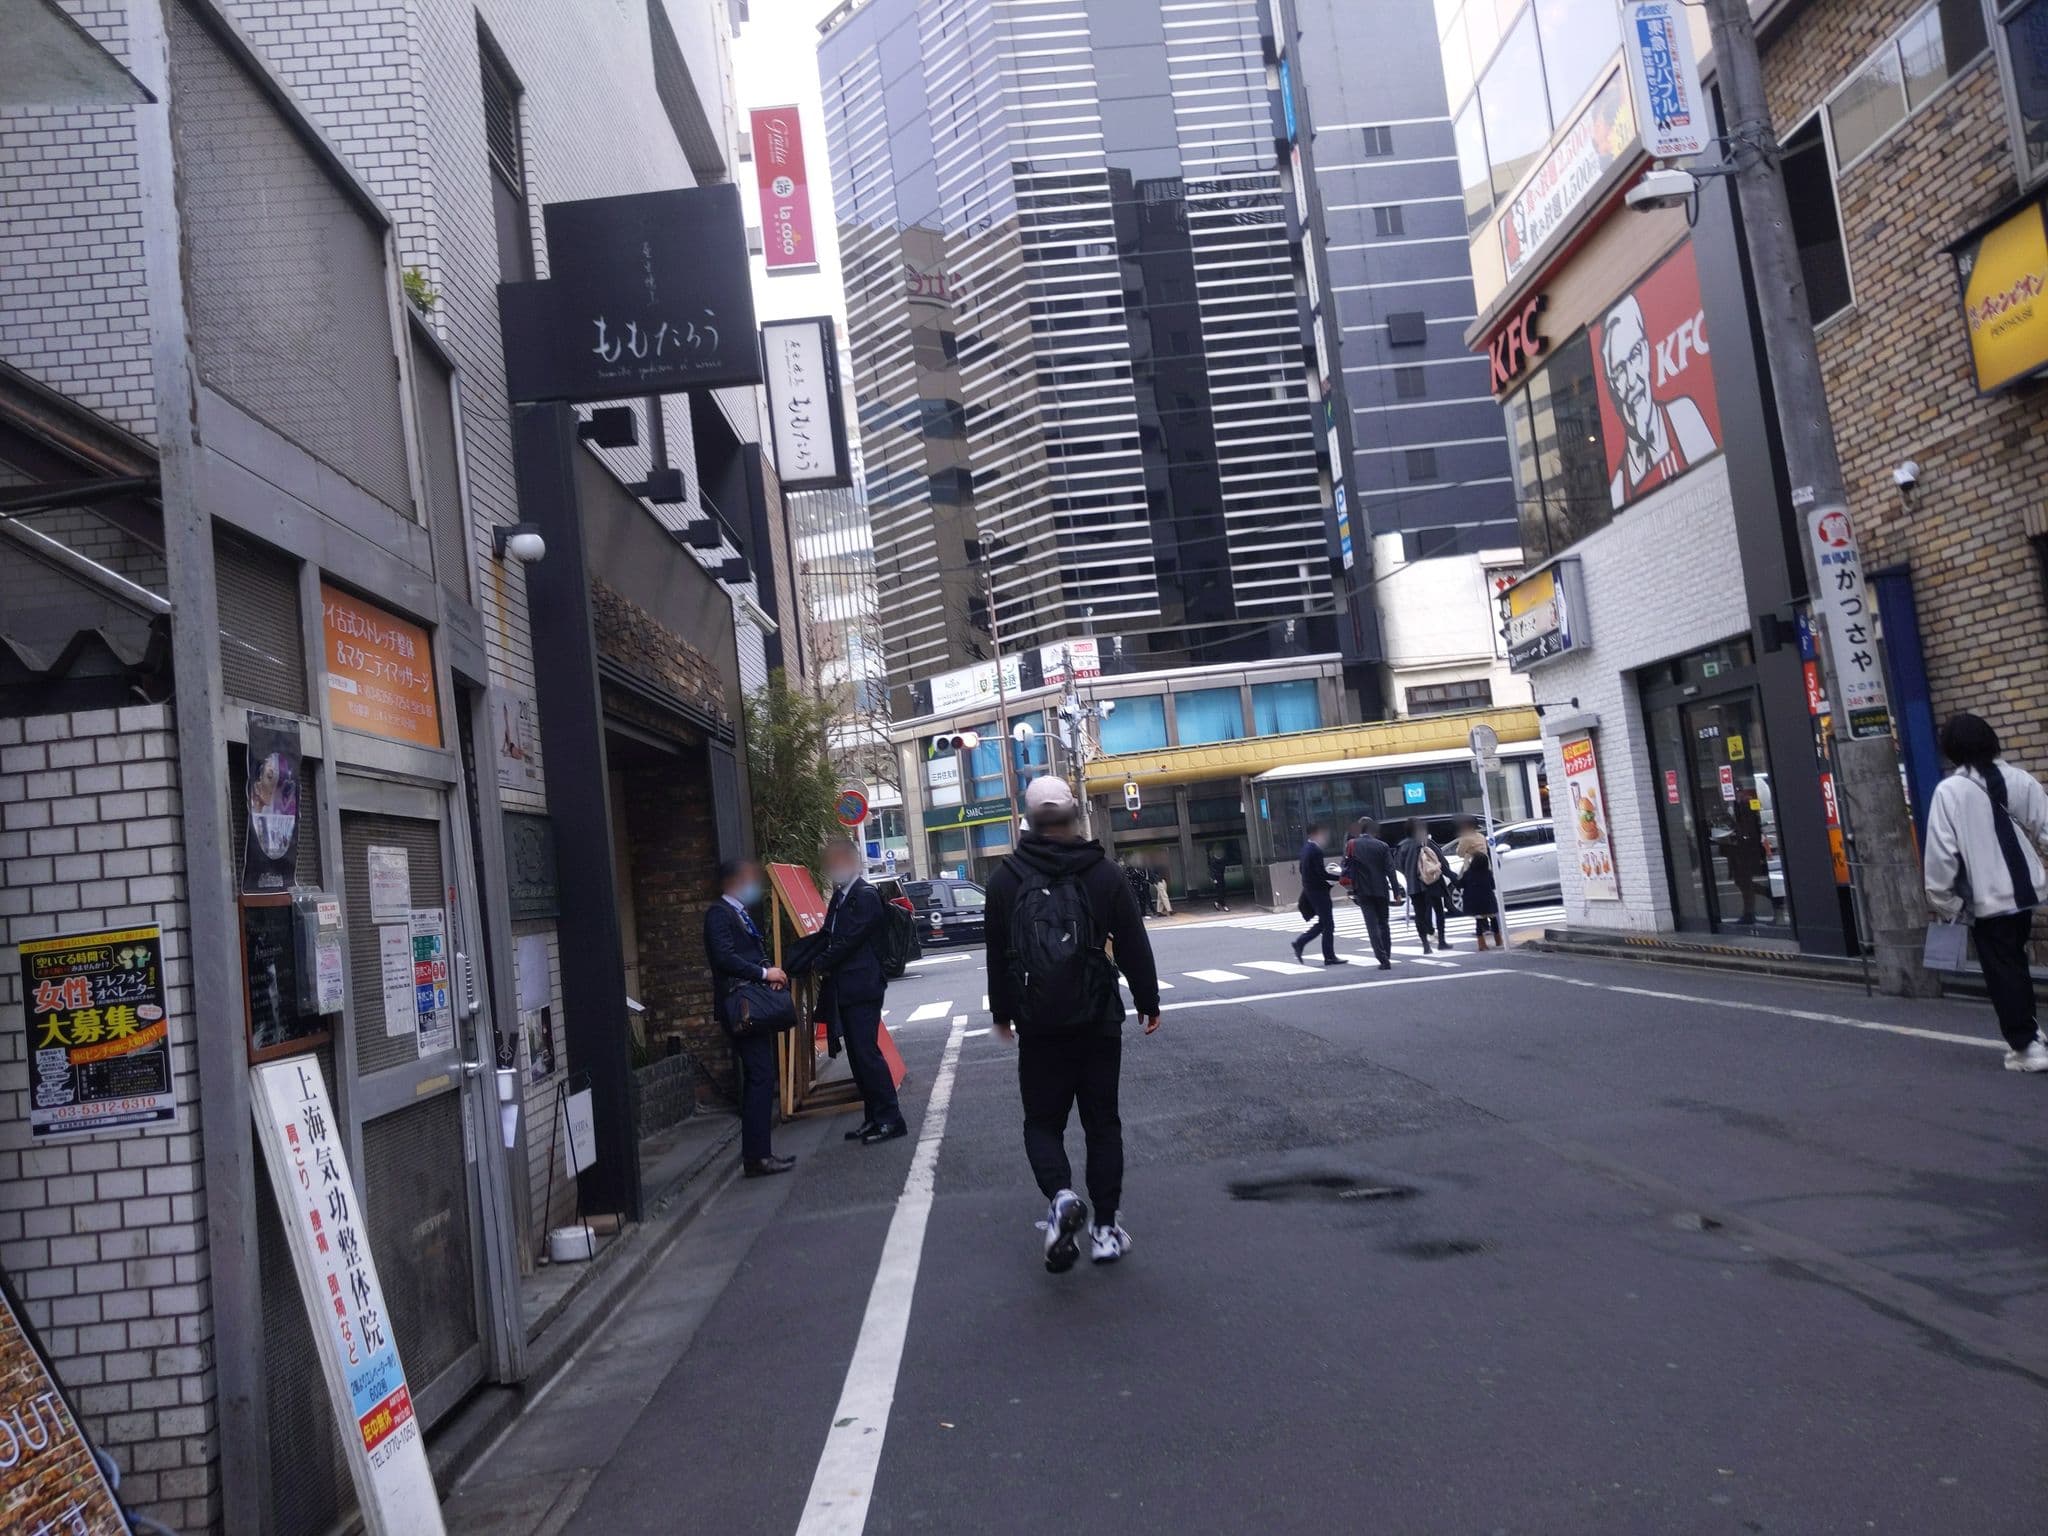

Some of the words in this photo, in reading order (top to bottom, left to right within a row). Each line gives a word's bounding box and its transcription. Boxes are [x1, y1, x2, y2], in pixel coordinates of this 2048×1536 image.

[1647, 20, 1678, 114] 東急リバブル
[775, 184, 791, 195] 3F
[781, 222, 796, 255] coco
[592, 308, 720, 363] ももたろう
[1488, 298, 1540, 395] KFC
[1655, 308, 1710, 388] KFC
[788, 396, 819, 471] ももたろう
[36, 950, 109, 968] 空いてる時間で
[95, 972, 147, 988] テレフォン
[33, 975, 94, 1014] 女性
[95, 984, 156, 1000] オペレーター
[36, 1004, 140, 1049] 大募集
[57, 1096, 156, 1119] 03-5312-6310
[297, 1066, 385, 1355] 上海気功整体院
[363, 1407, 393, 1443] 年中無休
[369, 1451, 386, 1471] TEL
[383, 1421, 417, 1460] 3770-1050
